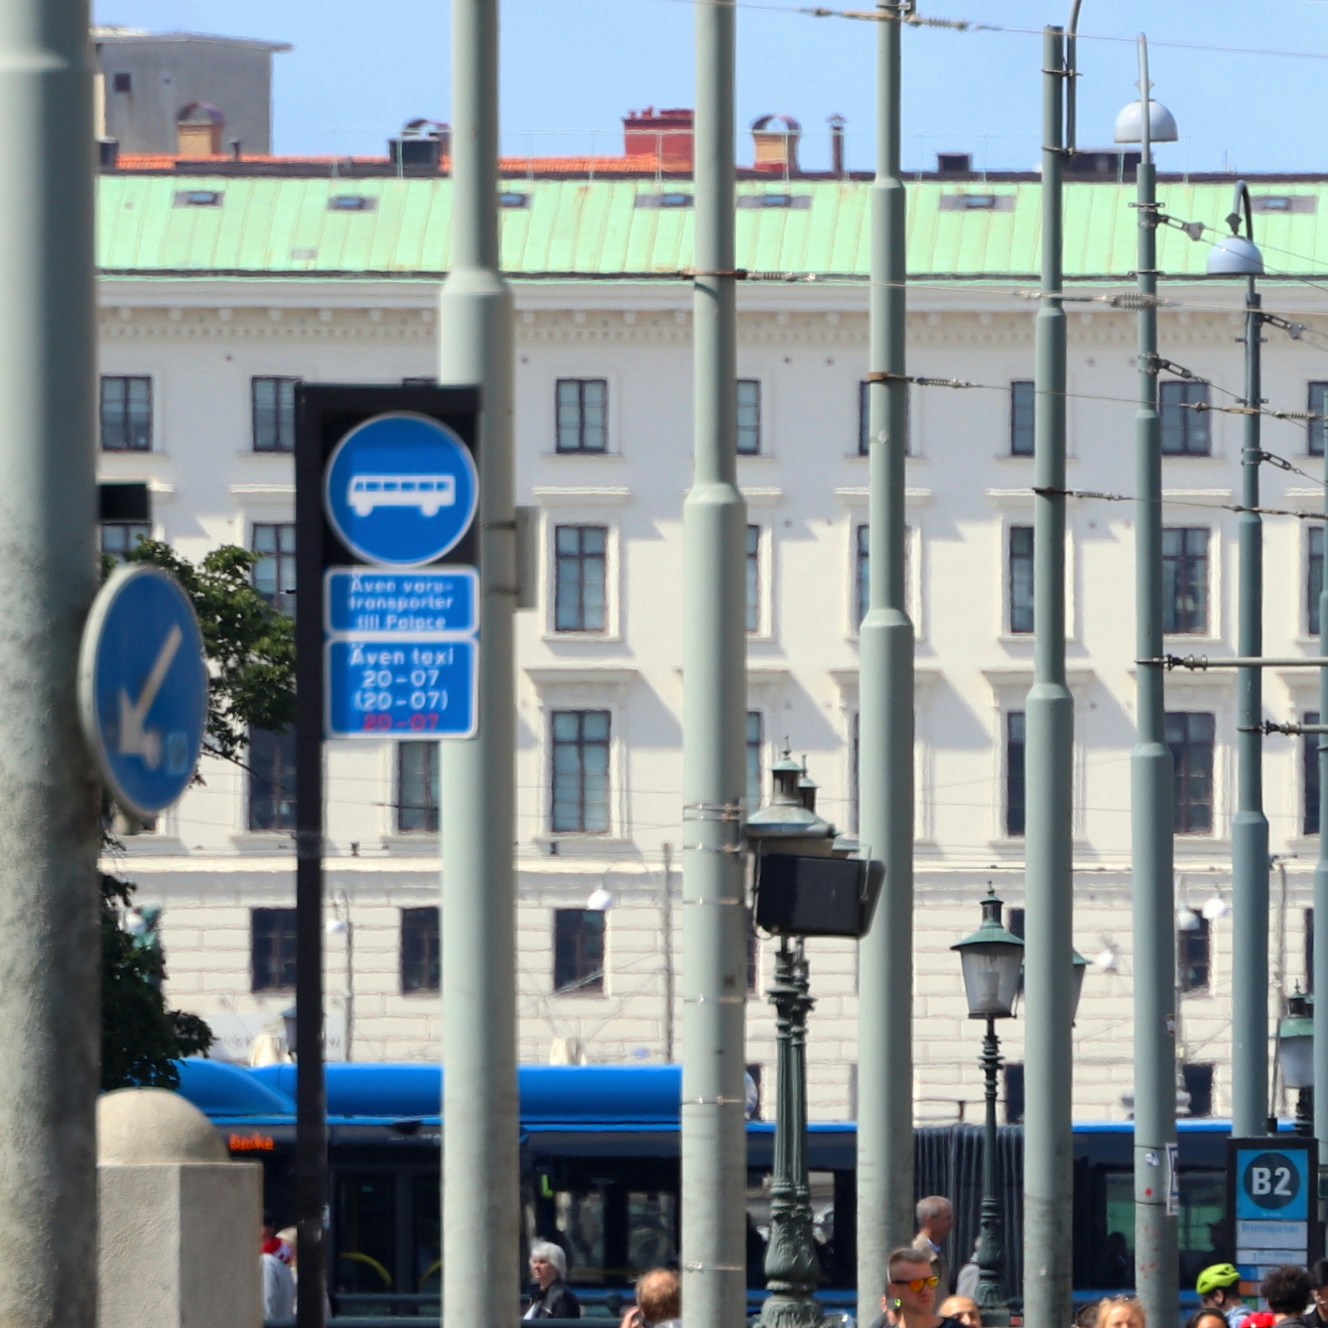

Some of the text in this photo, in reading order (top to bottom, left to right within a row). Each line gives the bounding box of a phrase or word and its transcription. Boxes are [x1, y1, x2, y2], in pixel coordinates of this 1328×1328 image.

[350, 574, 396, 593] Även
[350, 596, 454, 612] transporter
[357, 614, 447, 630] till Palace
[350, 643, 454, 665] Även taxi
[1251, 1166, 1293, 1196] B2
